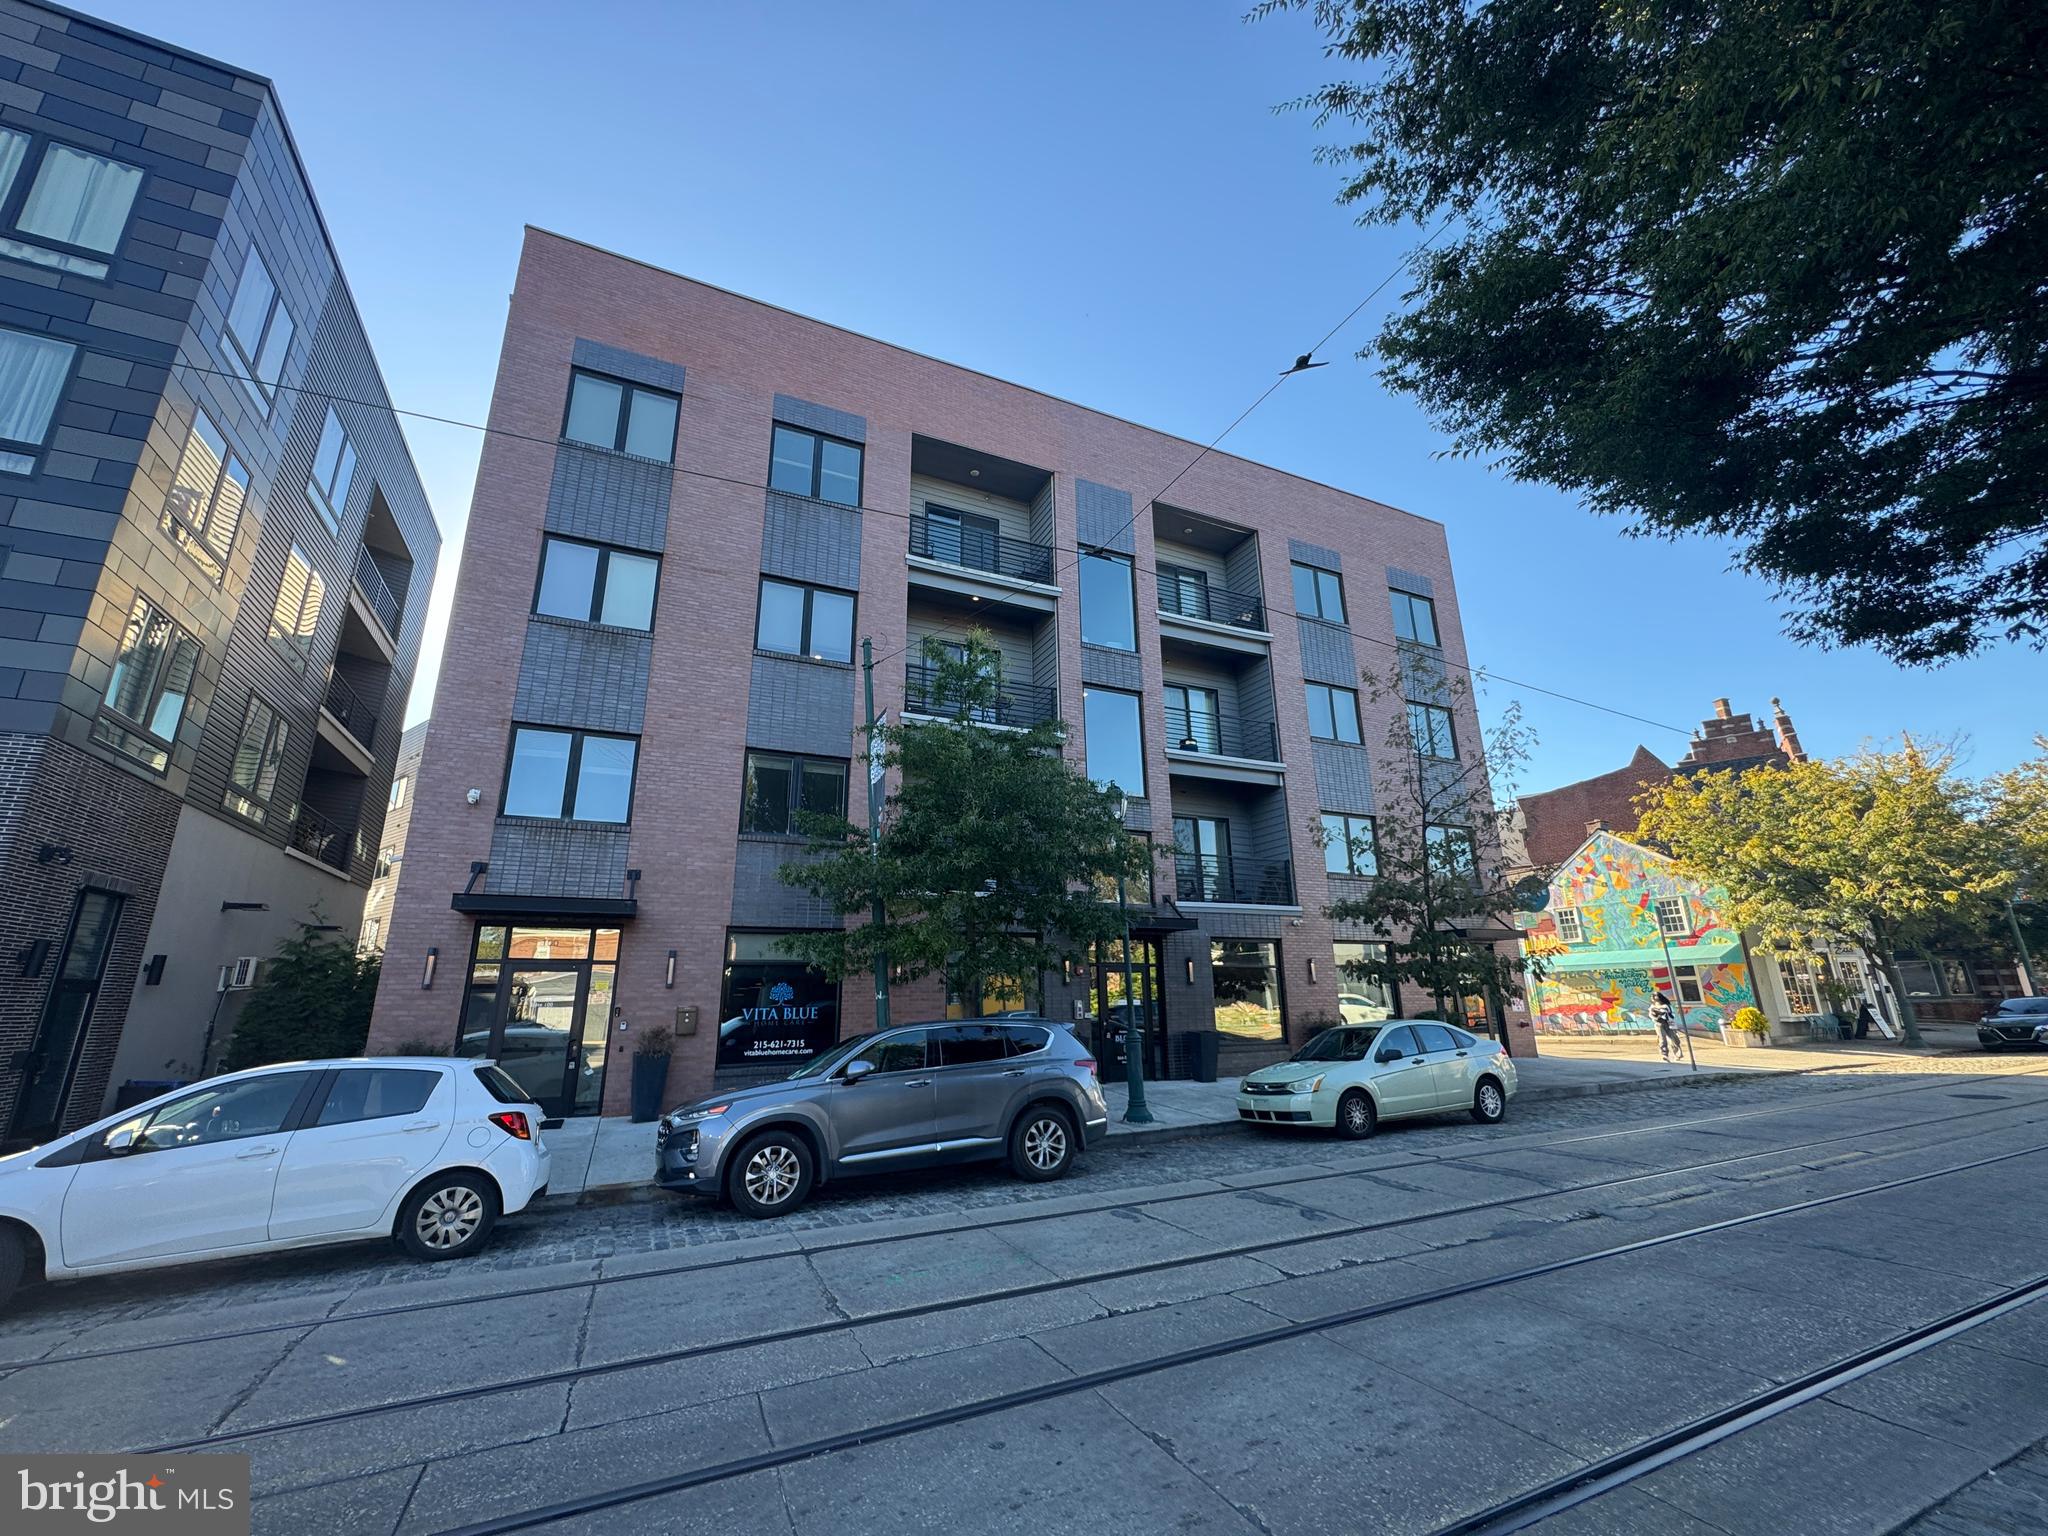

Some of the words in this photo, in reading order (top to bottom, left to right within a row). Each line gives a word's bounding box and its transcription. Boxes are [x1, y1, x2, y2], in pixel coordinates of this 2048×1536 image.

[742, 1007, 778, 1020] VITA
[783, 1007, 819, 1020] BLUE
[753, 1039, 805, 1049] 215-621-7315
[744, 1048, 813, 1057] vitabluehomecare.com
